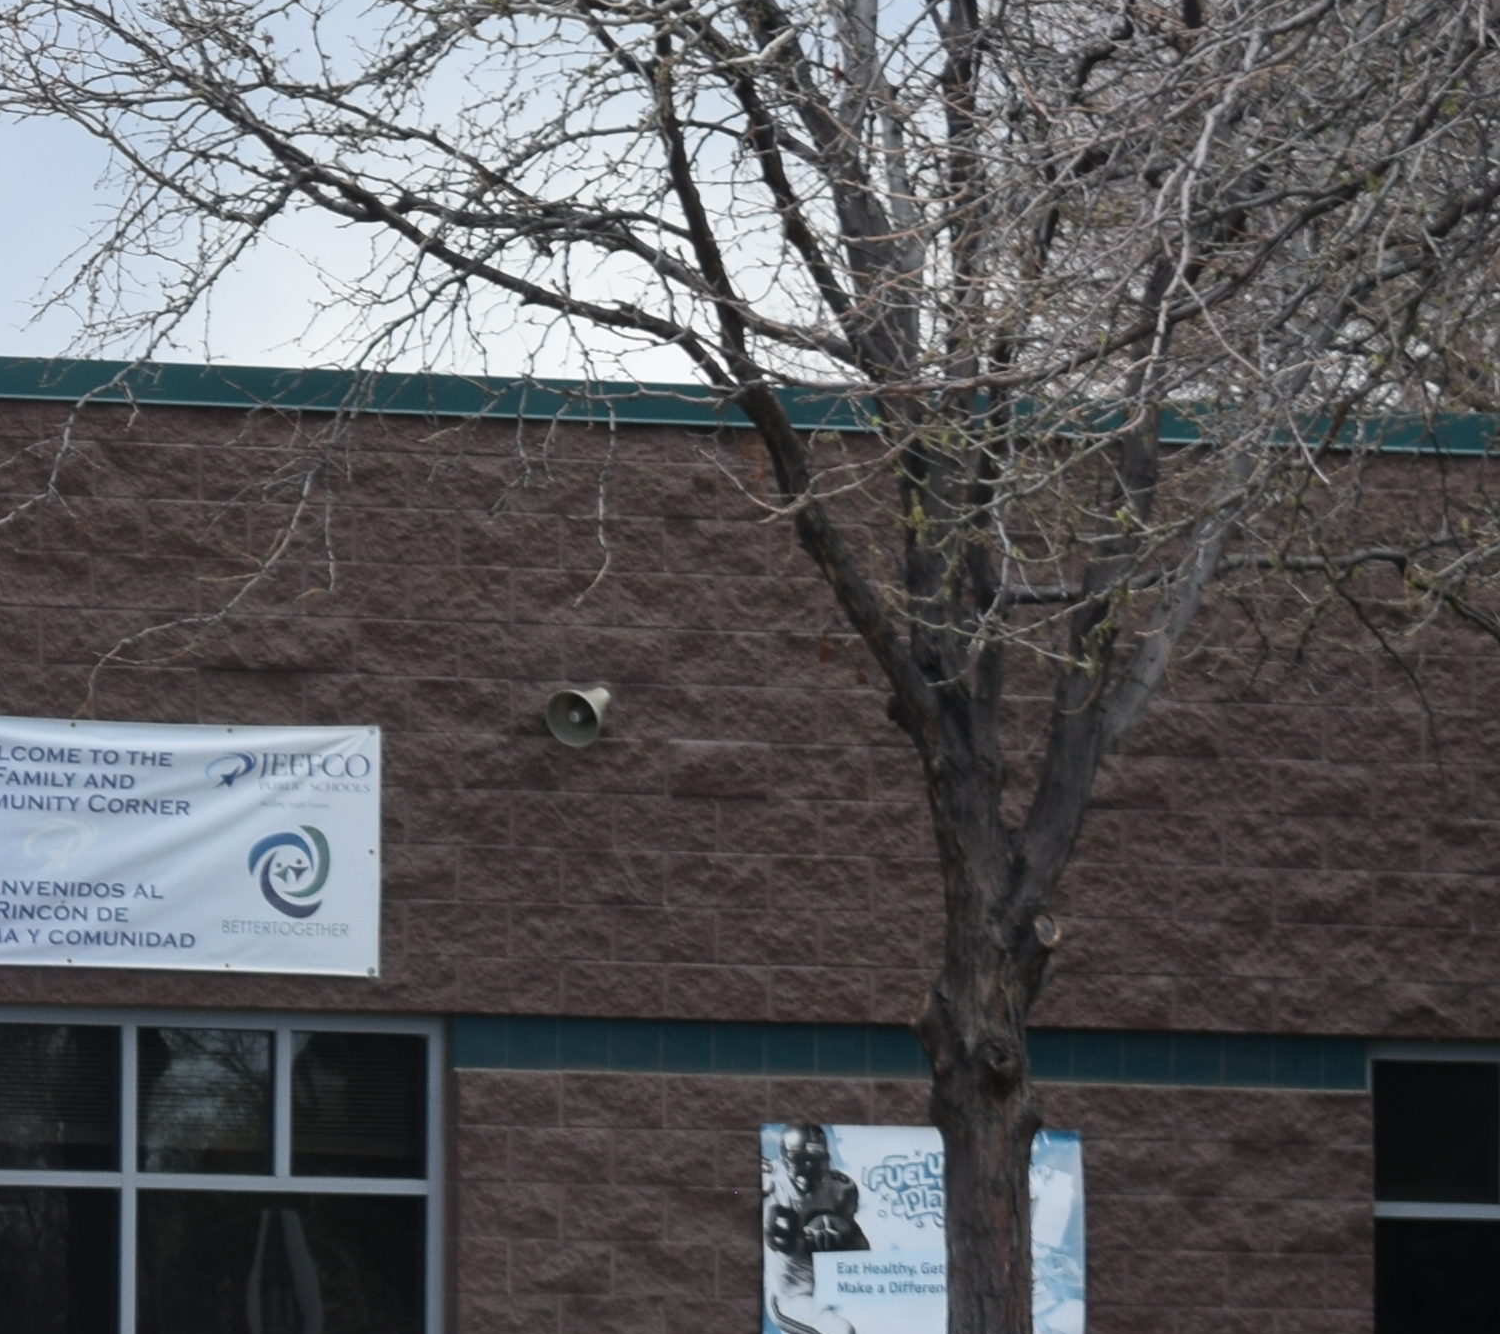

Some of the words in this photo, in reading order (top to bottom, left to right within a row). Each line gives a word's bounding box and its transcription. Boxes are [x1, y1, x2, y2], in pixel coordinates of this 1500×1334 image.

[89, 749, 119, 766] TO
[127, 750, 173, 768] THE
[258, 752, 371, 779] JEFFCO
[83, 773, 135, 790] AND
[87, 794, 191, 817] CORNER
[133, 884, 164, 900] AL
[97, 906, 130, 923] DE
[27, 928, 41, 945] Y
[48, 929, 197, 950] COMUNIDAD
[837, 1262, 858, 1274] Eat
[921, 1262, 945, 1274] Get
[837, 1282, 872, 1293] Make
[877, 1285, 884, 1293] a
